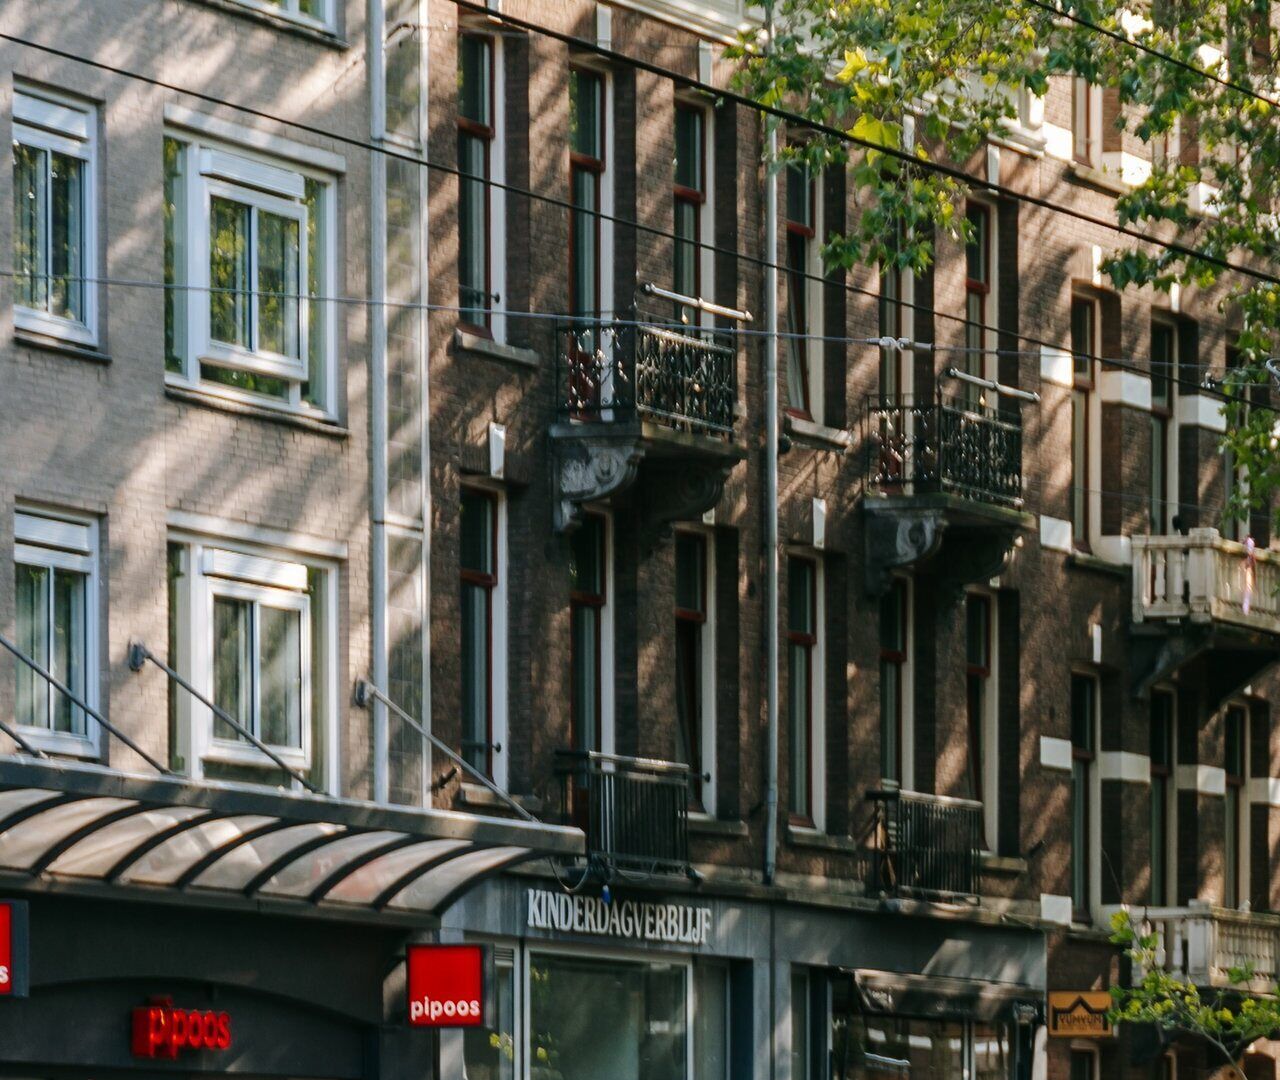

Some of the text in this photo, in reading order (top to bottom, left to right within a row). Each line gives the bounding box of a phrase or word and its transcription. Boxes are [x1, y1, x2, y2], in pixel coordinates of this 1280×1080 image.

[528, 888, 712, 945] KINDERDAGVERBLIJF
[145, 999, 232, 1059] pipoos
[411, 995, 481, 1021] pipoos
